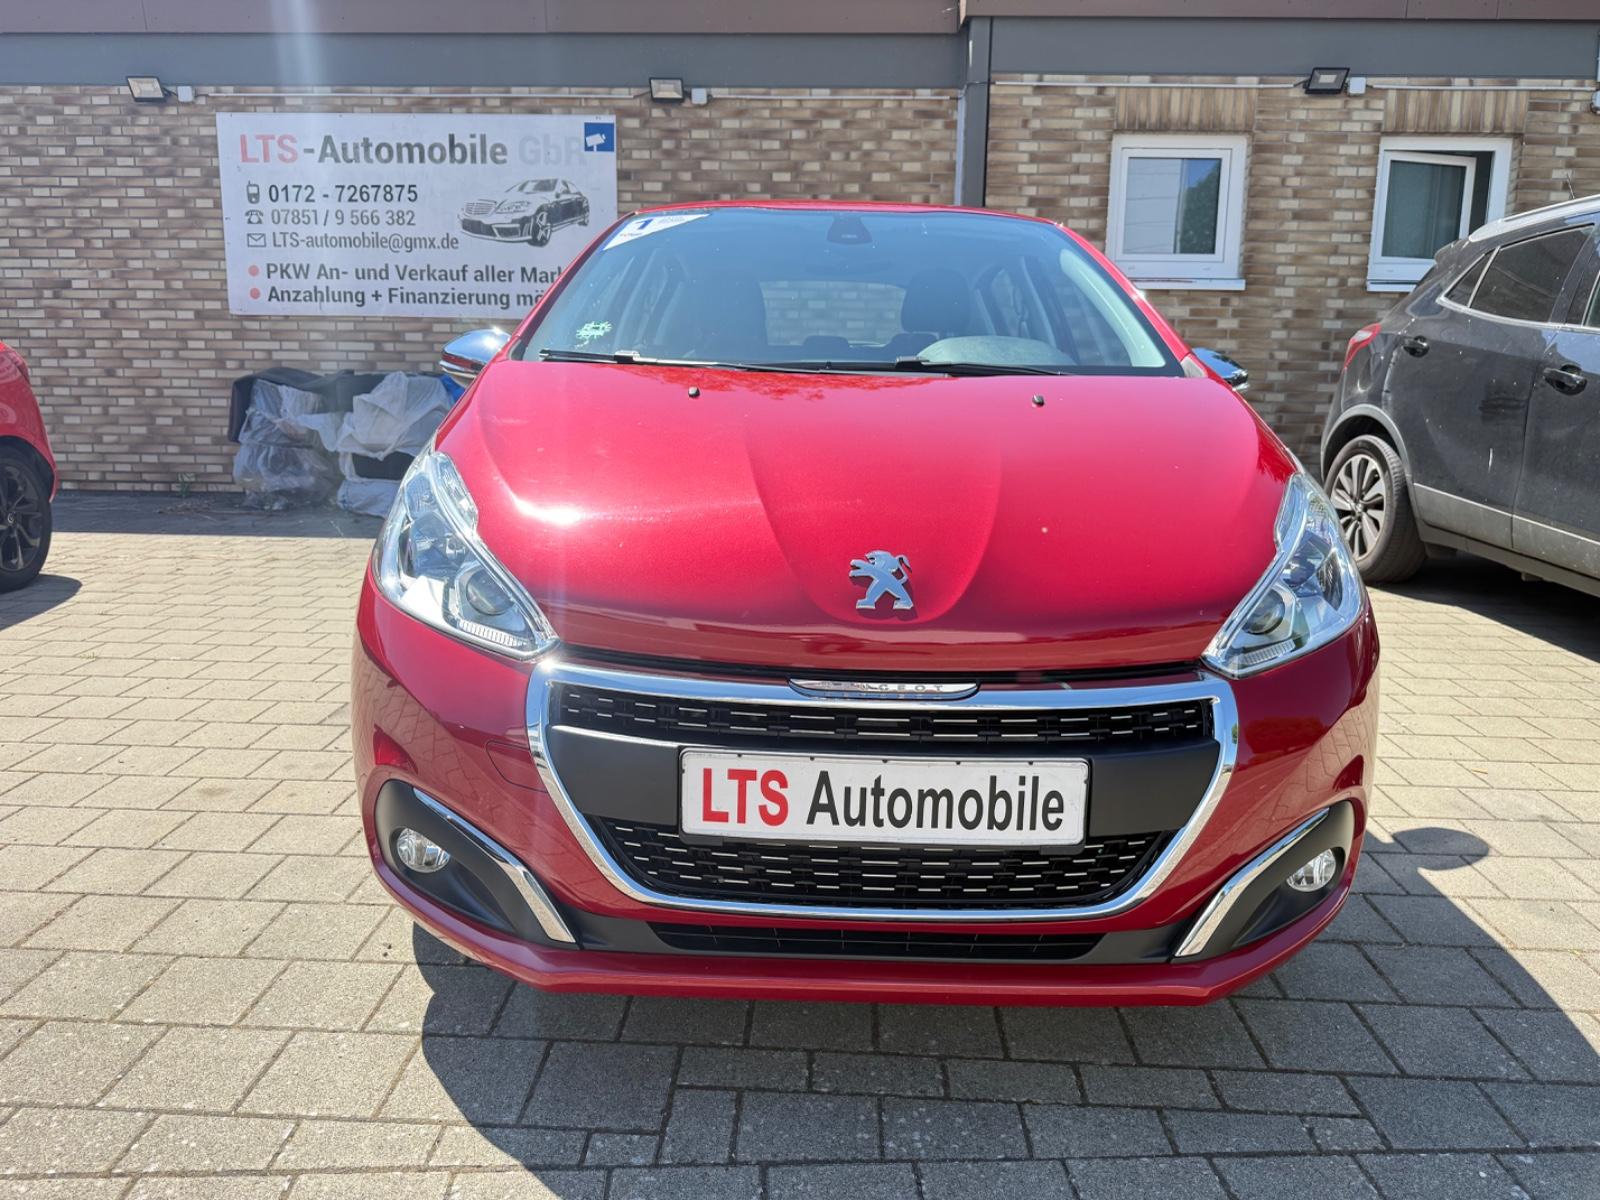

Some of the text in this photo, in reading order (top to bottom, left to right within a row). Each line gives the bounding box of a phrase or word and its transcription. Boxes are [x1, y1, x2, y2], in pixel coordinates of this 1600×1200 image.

[518, 133, 588, 165] GbR
[268, 184, 315, 203] 0172
[335, 184, 418, 203] 7267875
[271, 209, 318, 226] 07851
[335, 209, 344, 225] 9
[350, 210, 380, 226] 566
[385, 210, 416, 226] 382
[272, 231, 459, 253] LTS-automobile@gmx.de
[266, 263, 310, 279] PKW
[316, 263, 348, 280] An-
[354, 263, 389, 280] und
[395, 264, 468, 282] Verkauf
[473, 265, 515, 283] aller
[267, 286, 365, 307] Anzahlung
[371, 294, 382, 302] +
[388, 287, 510, 310] Finanzierung
[702, 767, 1064, 832] LTS Automobile
